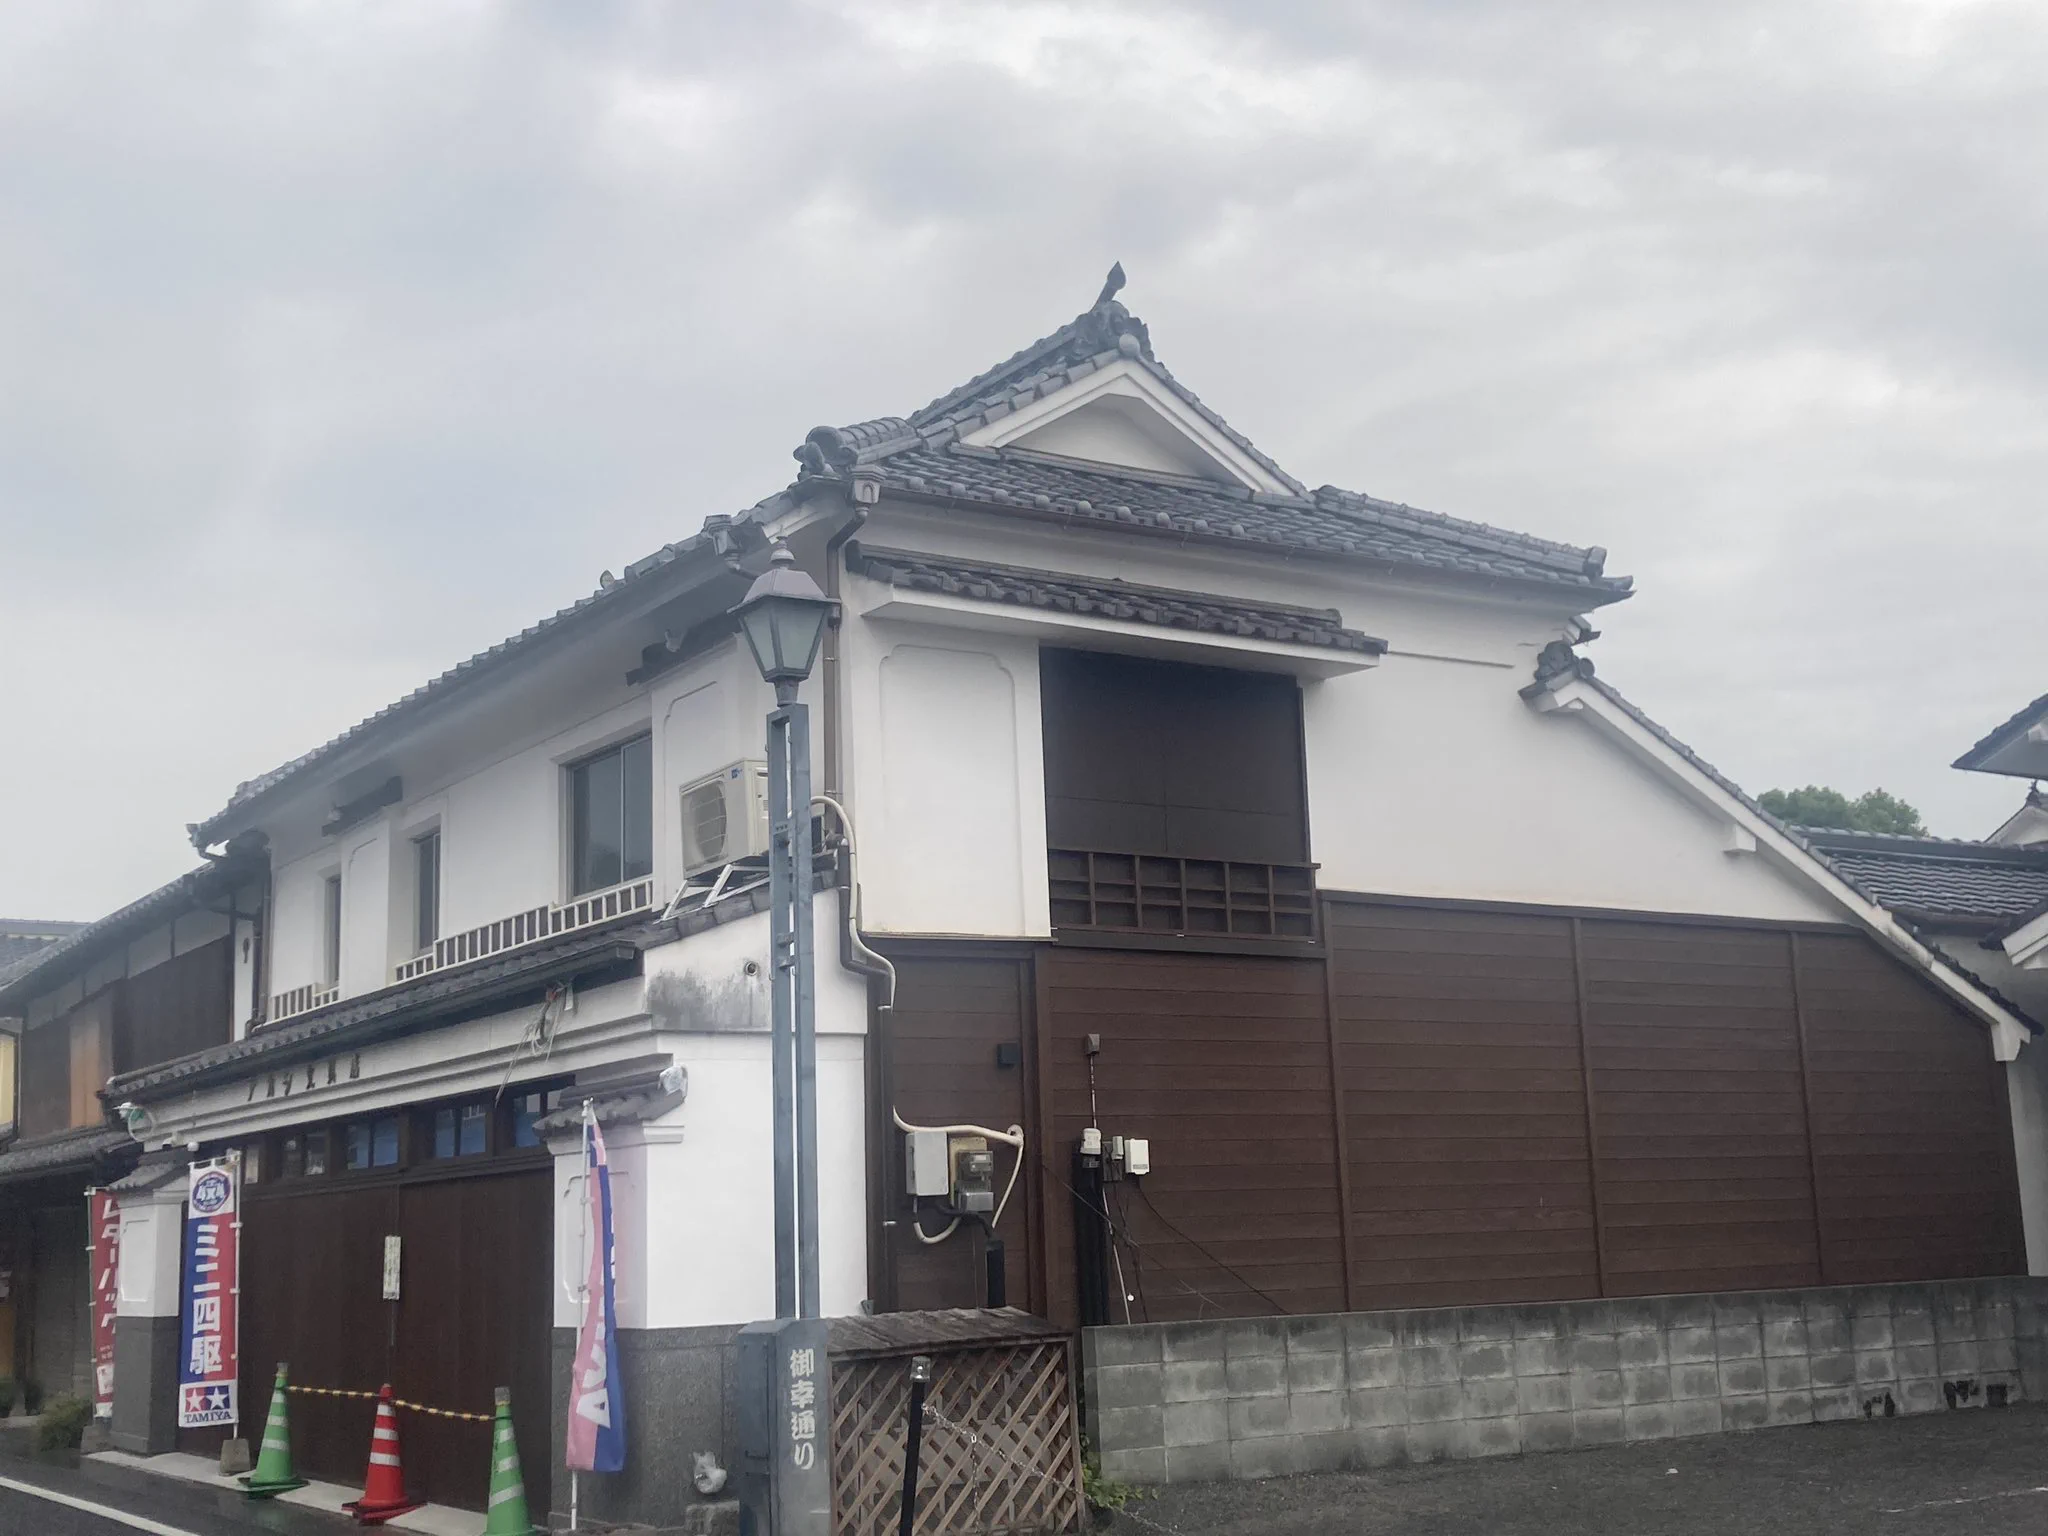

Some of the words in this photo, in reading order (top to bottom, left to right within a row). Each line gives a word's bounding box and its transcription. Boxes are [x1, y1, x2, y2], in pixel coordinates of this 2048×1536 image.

[189, 1225, 223, 1374] ミニ四駆
[184, 1411, 232, 1424] TAMIYA
[790, 1348, 816, 1470] 御幸通り
